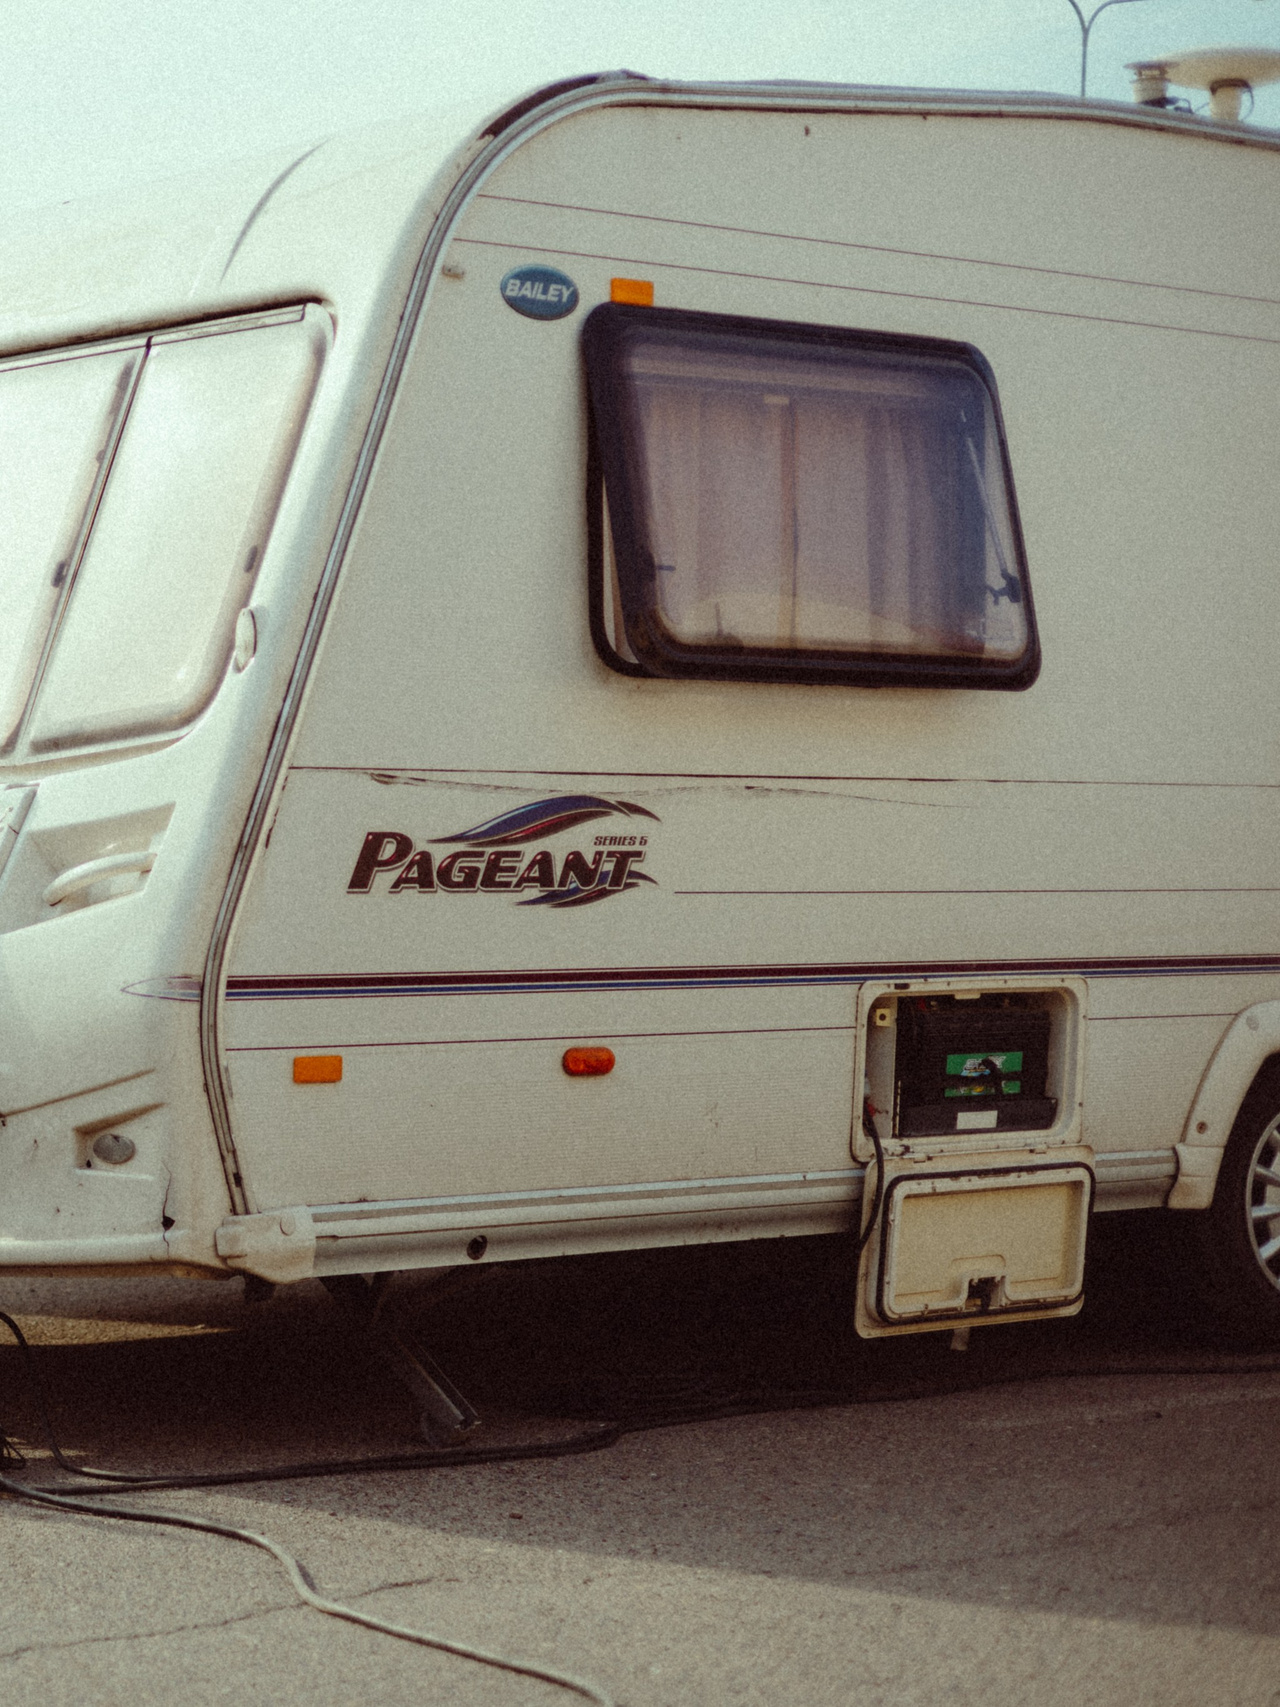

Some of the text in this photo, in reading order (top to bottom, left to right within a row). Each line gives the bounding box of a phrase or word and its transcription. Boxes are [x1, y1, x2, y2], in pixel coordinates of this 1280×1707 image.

[506, 279, 574, 303] BAILEY
[593, 835, 649, 847] SERIES 5
[346, 831, 645, 893] PAGEANT
